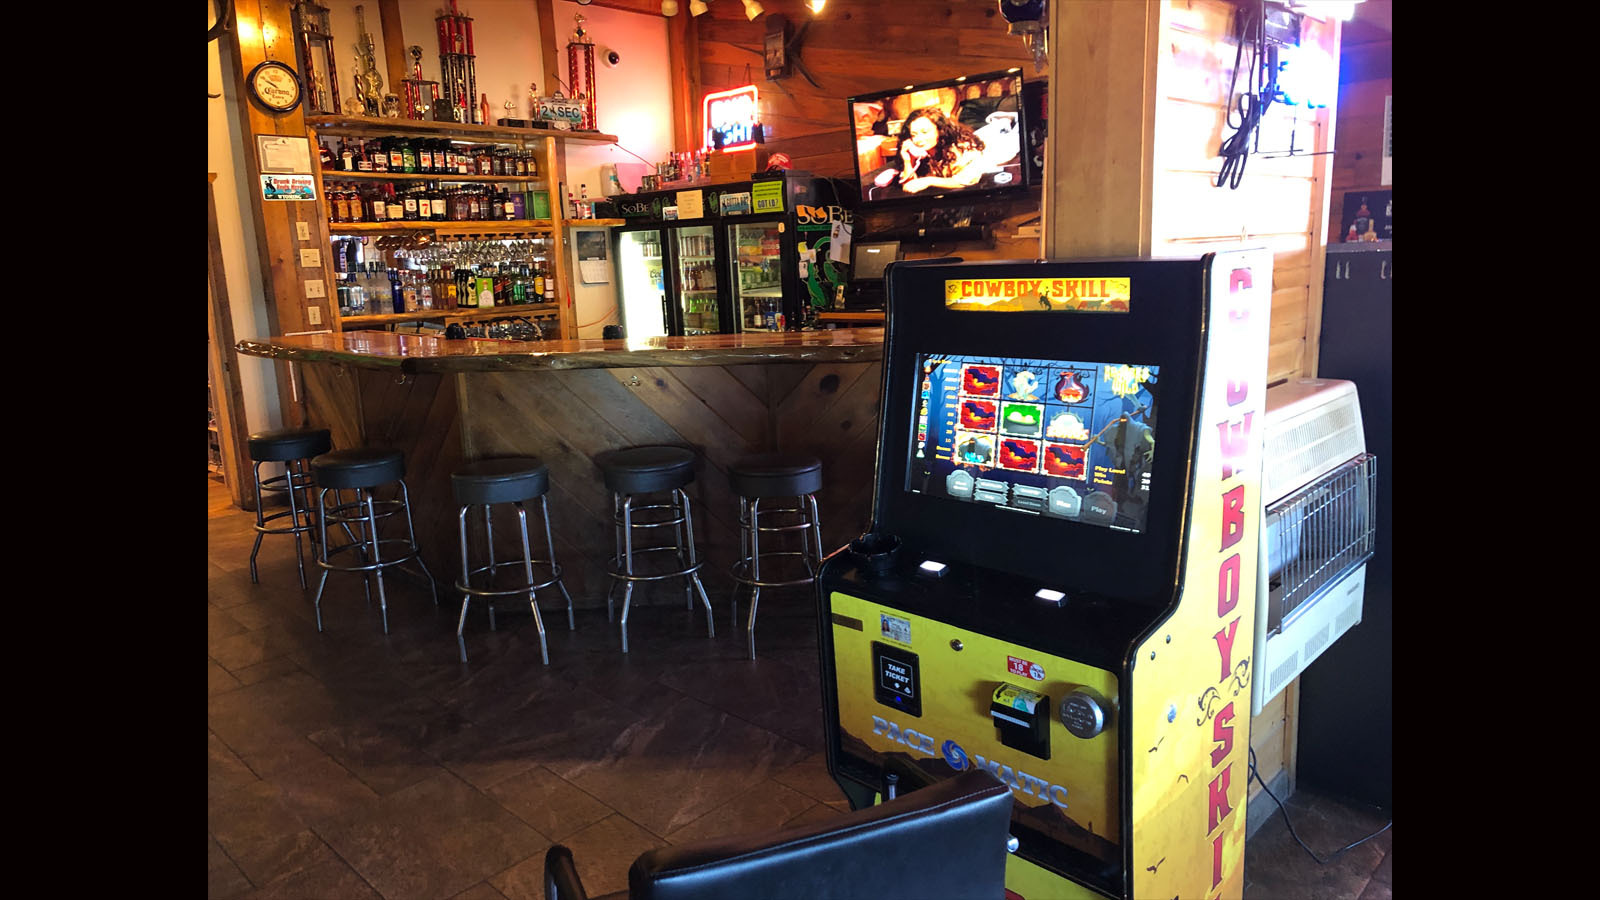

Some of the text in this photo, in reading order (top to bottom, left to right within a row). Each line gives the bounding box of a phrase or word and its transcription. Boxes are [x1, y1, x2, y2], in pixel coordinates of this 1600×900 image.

[264, 87, 290, 96] Corona
[557, 106, 580, 119] SEC
[292, 178, 312, 186] Driving
[421, 203, 430, 215] 7
[961, 280, 1111, 298] COWBOY SKILL
[1094, 465, 1126, 475] Play Level
[1090, 505, 1107, 515] Play
[887, 663, 906, 675] TAKE
[1013, 662, 1024, 672] 18
[885, 670, 909, 684] TICKET
[871, 714, 935, 757] PACE
[974, 753, 1069, 809] MATIC
